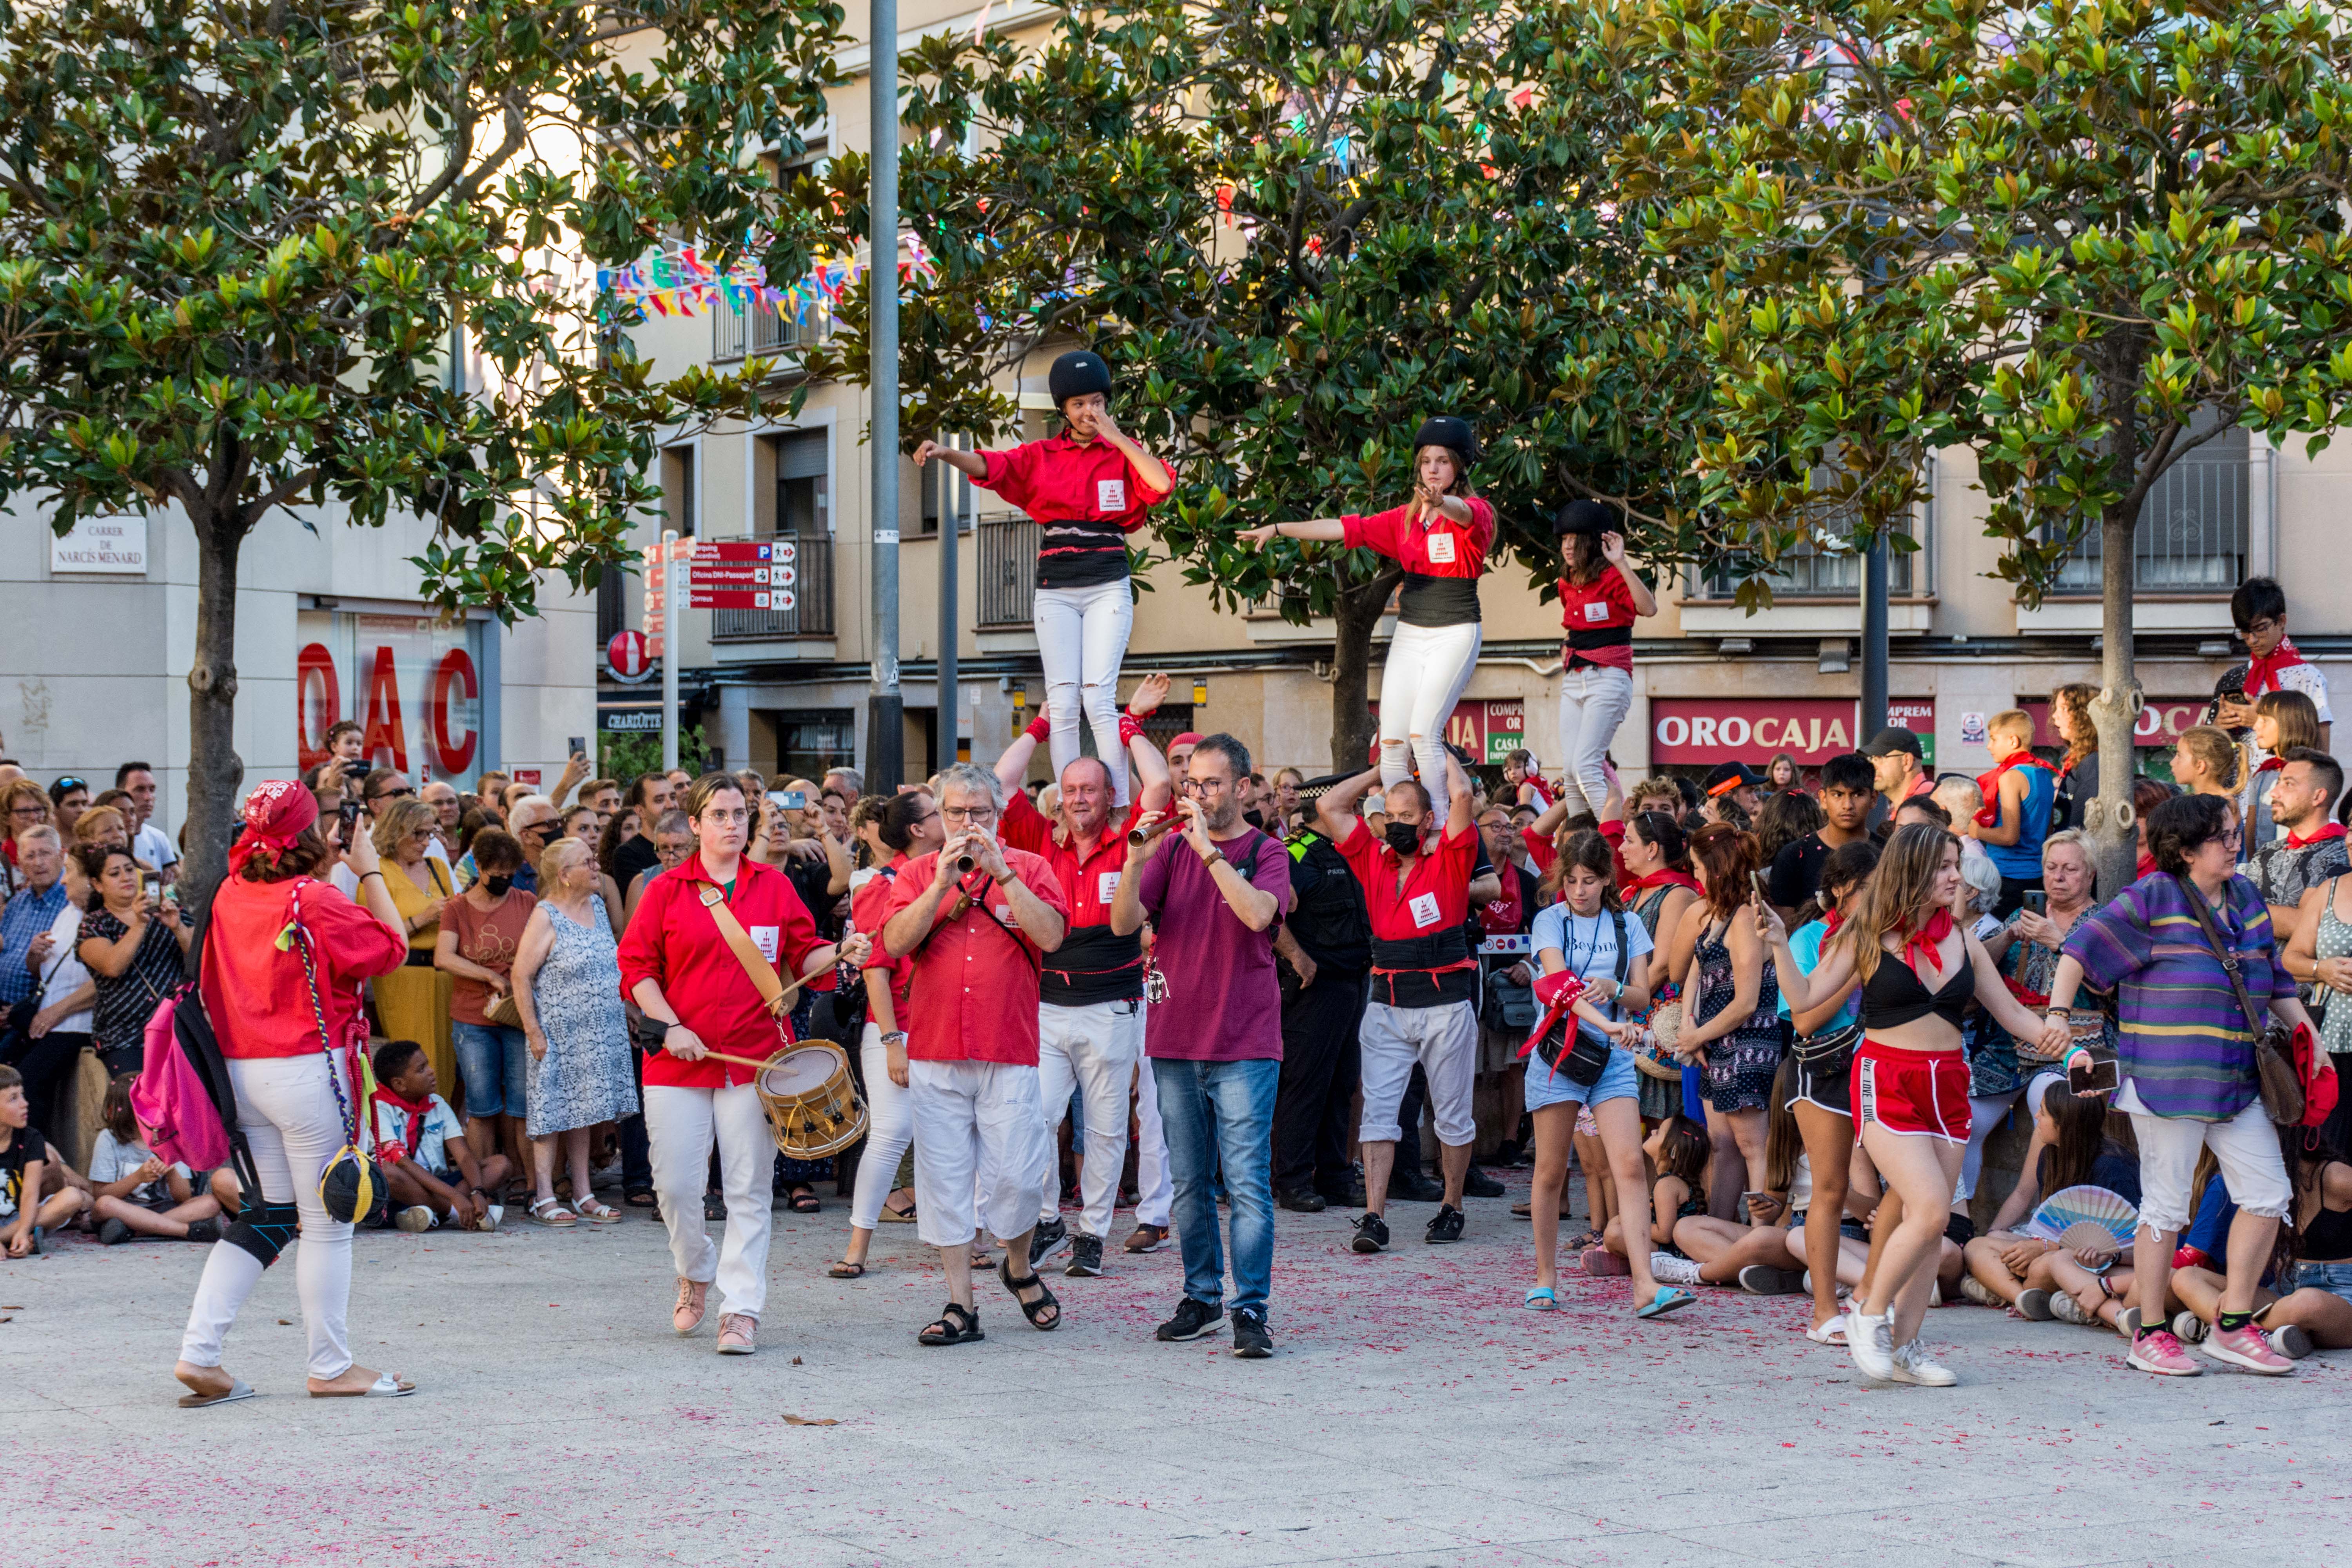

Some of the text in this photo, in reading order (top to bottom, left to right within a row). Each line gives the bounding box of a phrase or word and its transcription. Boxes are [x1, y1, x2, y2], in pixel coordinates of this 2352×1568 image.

[87, 526, 124, 536] CARRER
[100, 540, 112, 549] DE
[98, 551, 142, 564] MENARD
[713, 571, 753, 580] DNI-Passaport
[298, 642, 478, 775] OAC
[1506, 717, 1521, 730] OR
[1887, 717, 1907, 728] OR
[1656, 716, 1850, 753] OROCAJA
[1495, 738, 1518, 751] CASA
